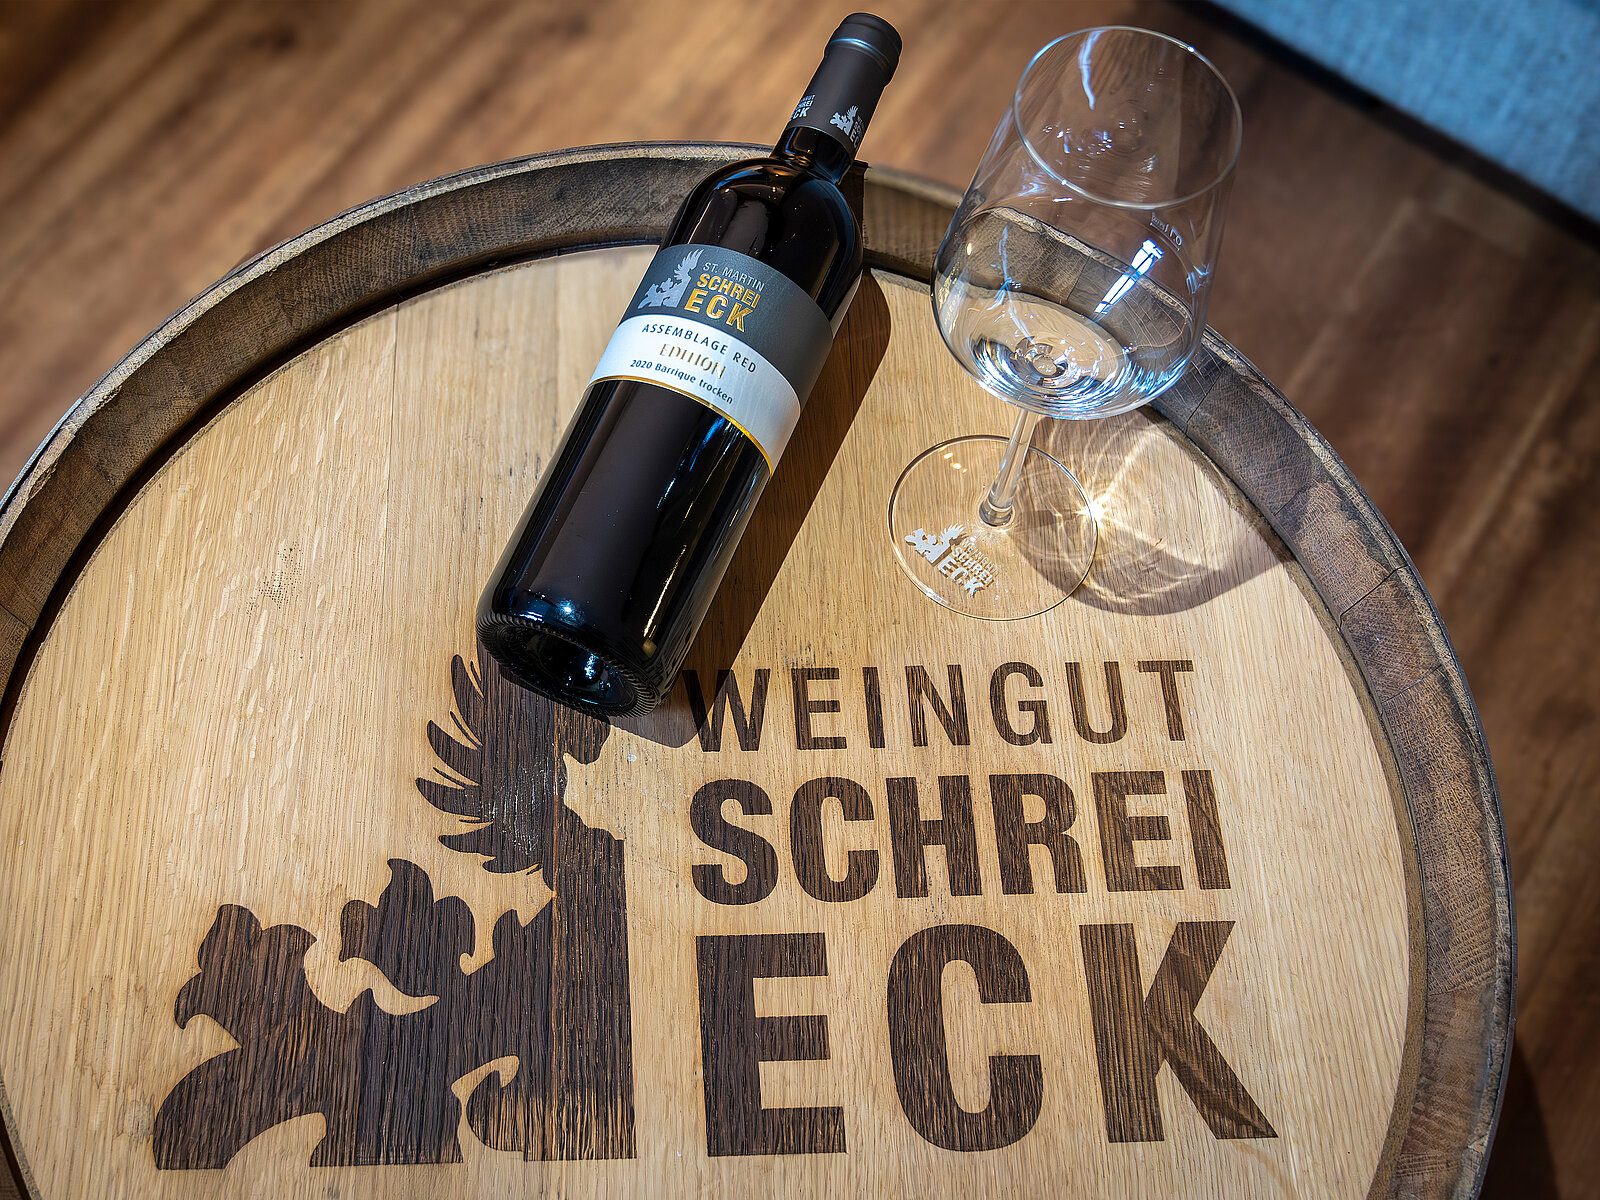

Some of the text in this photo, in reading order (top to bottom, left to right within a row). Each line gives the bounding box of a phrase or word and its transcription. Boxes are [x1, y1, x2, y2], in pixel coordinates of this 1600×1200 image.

[696, 273, 762, 309] SCHREI
[703, 262, 765, 292] ST. MARTIN
[684, 288, 753, 333] ECK
[641, 323, 757, 373] ASSEMBLAGE RED
[659, 343, 727, 380] EDITION
[630, 359, 734, 404] 2020 Barrique trocken
[937, 555, 984, 596] ECK
[952, 546, 993, 583] SCHREI
[683, 660, 1193, 752] WEINGUT
[689, 771, 1231, 905] SCHREI
[695, 920, 1278, 1157] ECK
